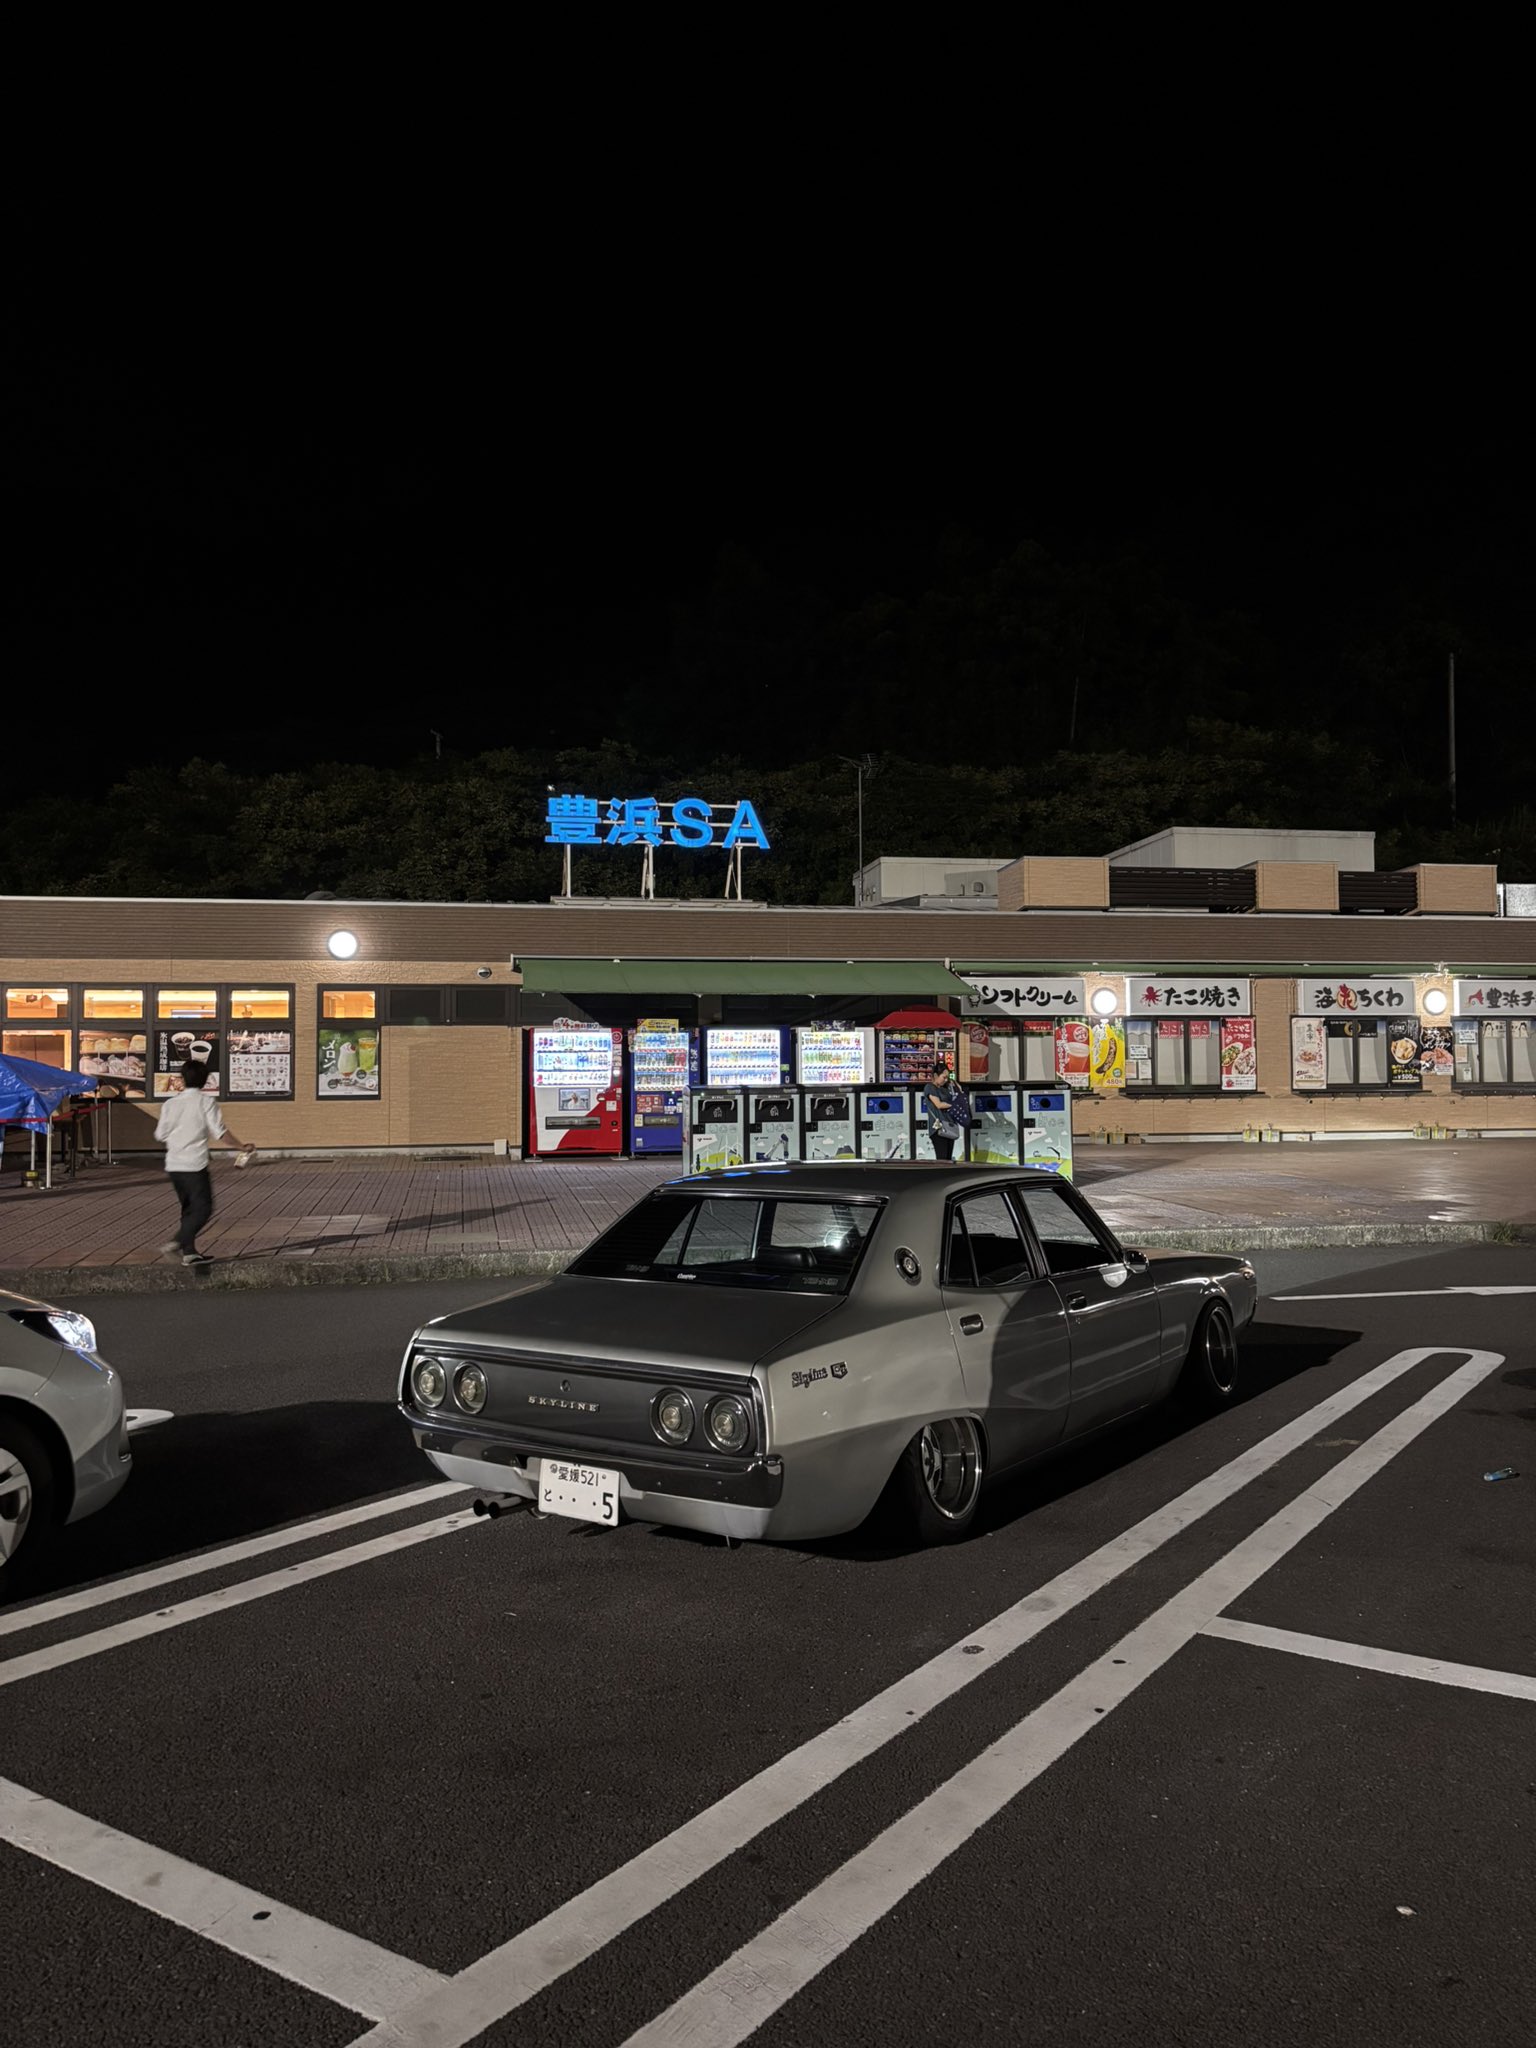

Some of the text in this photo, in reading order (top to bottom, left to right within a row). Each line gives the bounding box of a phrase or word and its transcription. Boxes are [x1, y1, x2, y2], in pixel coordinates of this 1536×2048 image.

[544, 794, 771, 849] 豊浜SA
[981, 985, 1078, 1007] ソフトクリーム
[1163, 985, 1241, 1008] たこ焼き
[1314, 983, 1404, 1011] 海老ちくわ
[1486, 986, 1536, 1009] 豊浜子
[322, 1040, 336, 1068] メロン
[528, 1395, 600, 1412] SKYLINE
[544, 1488, 552, 1502] と
